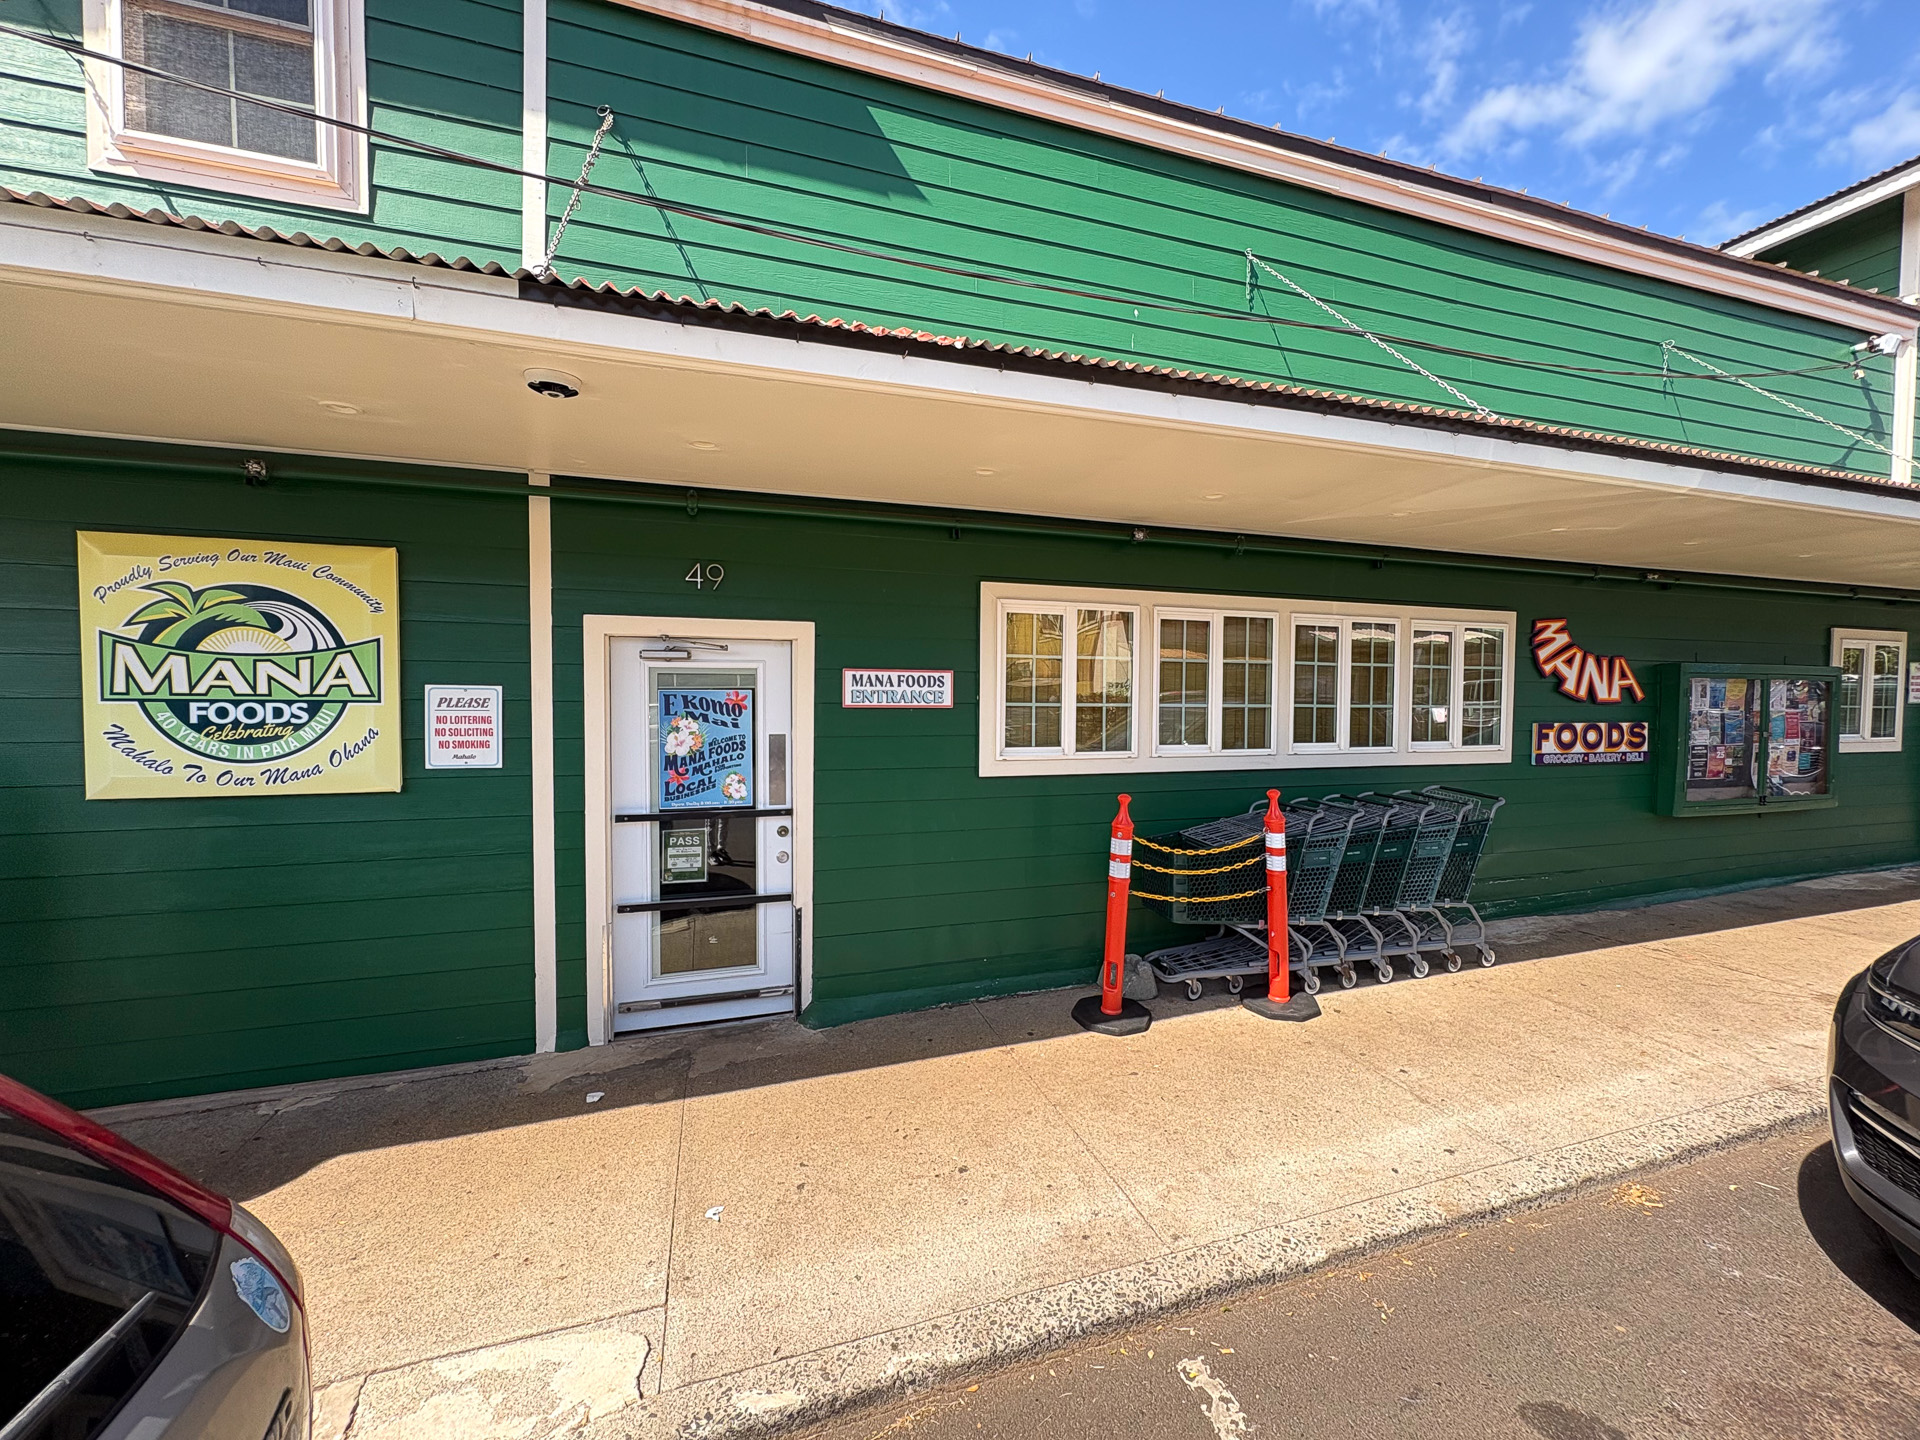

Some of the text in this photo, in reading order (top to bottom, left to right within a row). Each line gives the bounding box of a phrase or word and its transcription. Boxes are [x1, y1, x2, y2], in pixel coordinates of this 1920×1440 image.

[94, 549, 385, 614] Proudly Serving Our Maui Community
[685, 563, 725, 590] 49
[111, 641, 375, 697] MANA
[1533, 618, 1645, 703] MANA
[851, 674, 945, 688] MANA FOODS
[437, 697, 491, 708] PLEASE
[663, 693, 678, 716] E
[850, 689, 944, 704] ENTRANCE
[189, 702, 309, 724] FOODS
[436, 715, 492, 725] NO LOITERING
[684, 710, 740, 728] Mai
[156, 708, 336, 759] 40 YEARS IN PAIA MAUI
[200, 724, 294, 741] Celebrating
[434, 728, 494, 737] NO SOLICITING
[708, 735, 738, 747] WELCOME
[1534, 722, 1647, 753] FOODS
[438, 740, 490, 749] NO SMOKING
[103, 724, 379, 787] Mahalo To Our Mana Ohana
[664, 740, 746, 776] MANA FOODS
[691, 753, 745, 776] MAHALO
[1543, 752, 1644, 764] GROCERY BAKERY DELI
[664, 776, 717, 796] LOCAL
[664, 784, 717, 802] BUSINESSES
[670, 836, 700, 845] PASS
